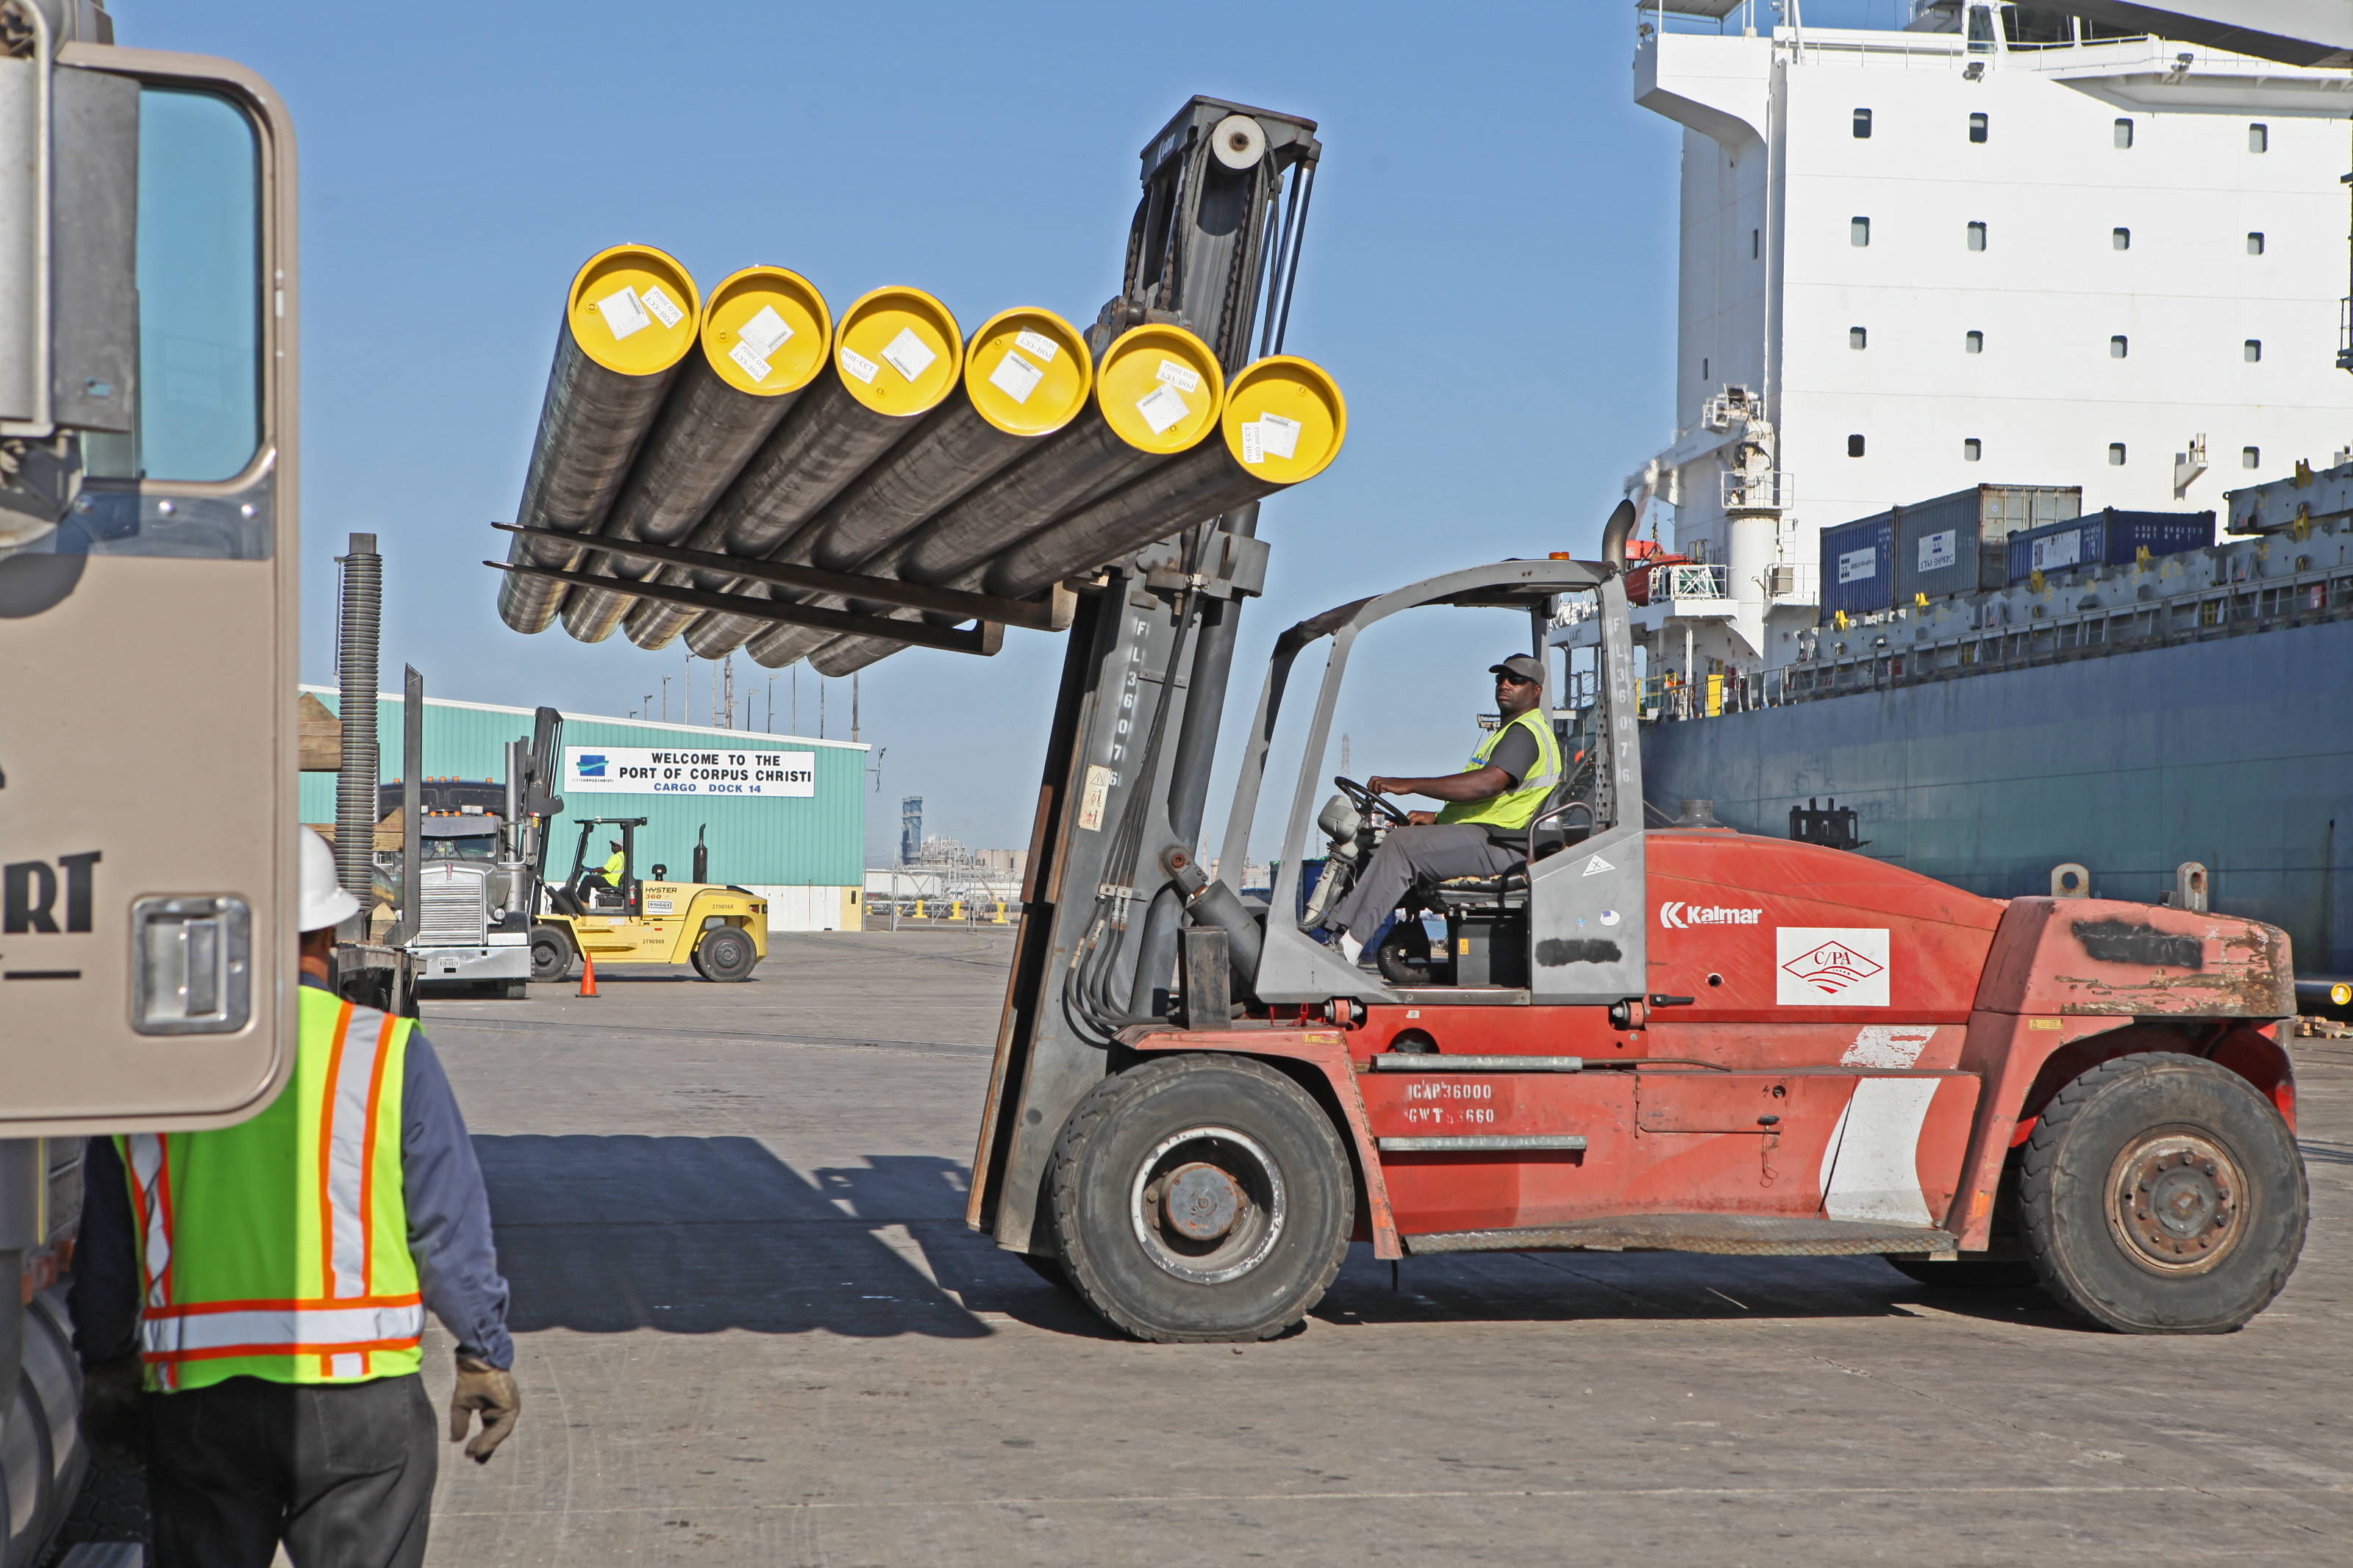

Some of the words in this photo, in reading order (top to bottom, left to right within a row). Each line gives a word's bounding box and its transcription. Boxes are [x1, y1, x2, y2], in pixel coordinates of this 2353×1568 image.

[651, 752, 719, 765] WELCOME
[728, 754, 746, 766] TO
[755, 755, 780, 766] THE
[619, 767, 657, 779] PORT
[663, 767, 682, 779] OF
[690, 768, 749, 781] CORPUS
[755, 770, 811, 782] CHRISTI
[654, 783, 696, 792] CARGO
[709, 784, 743, 792] DOCK
[749, 784, 761, 793] 14
[1687, 906, 1763, 924] Kalmar
[1814, 951, 1852, 966] C/PA
